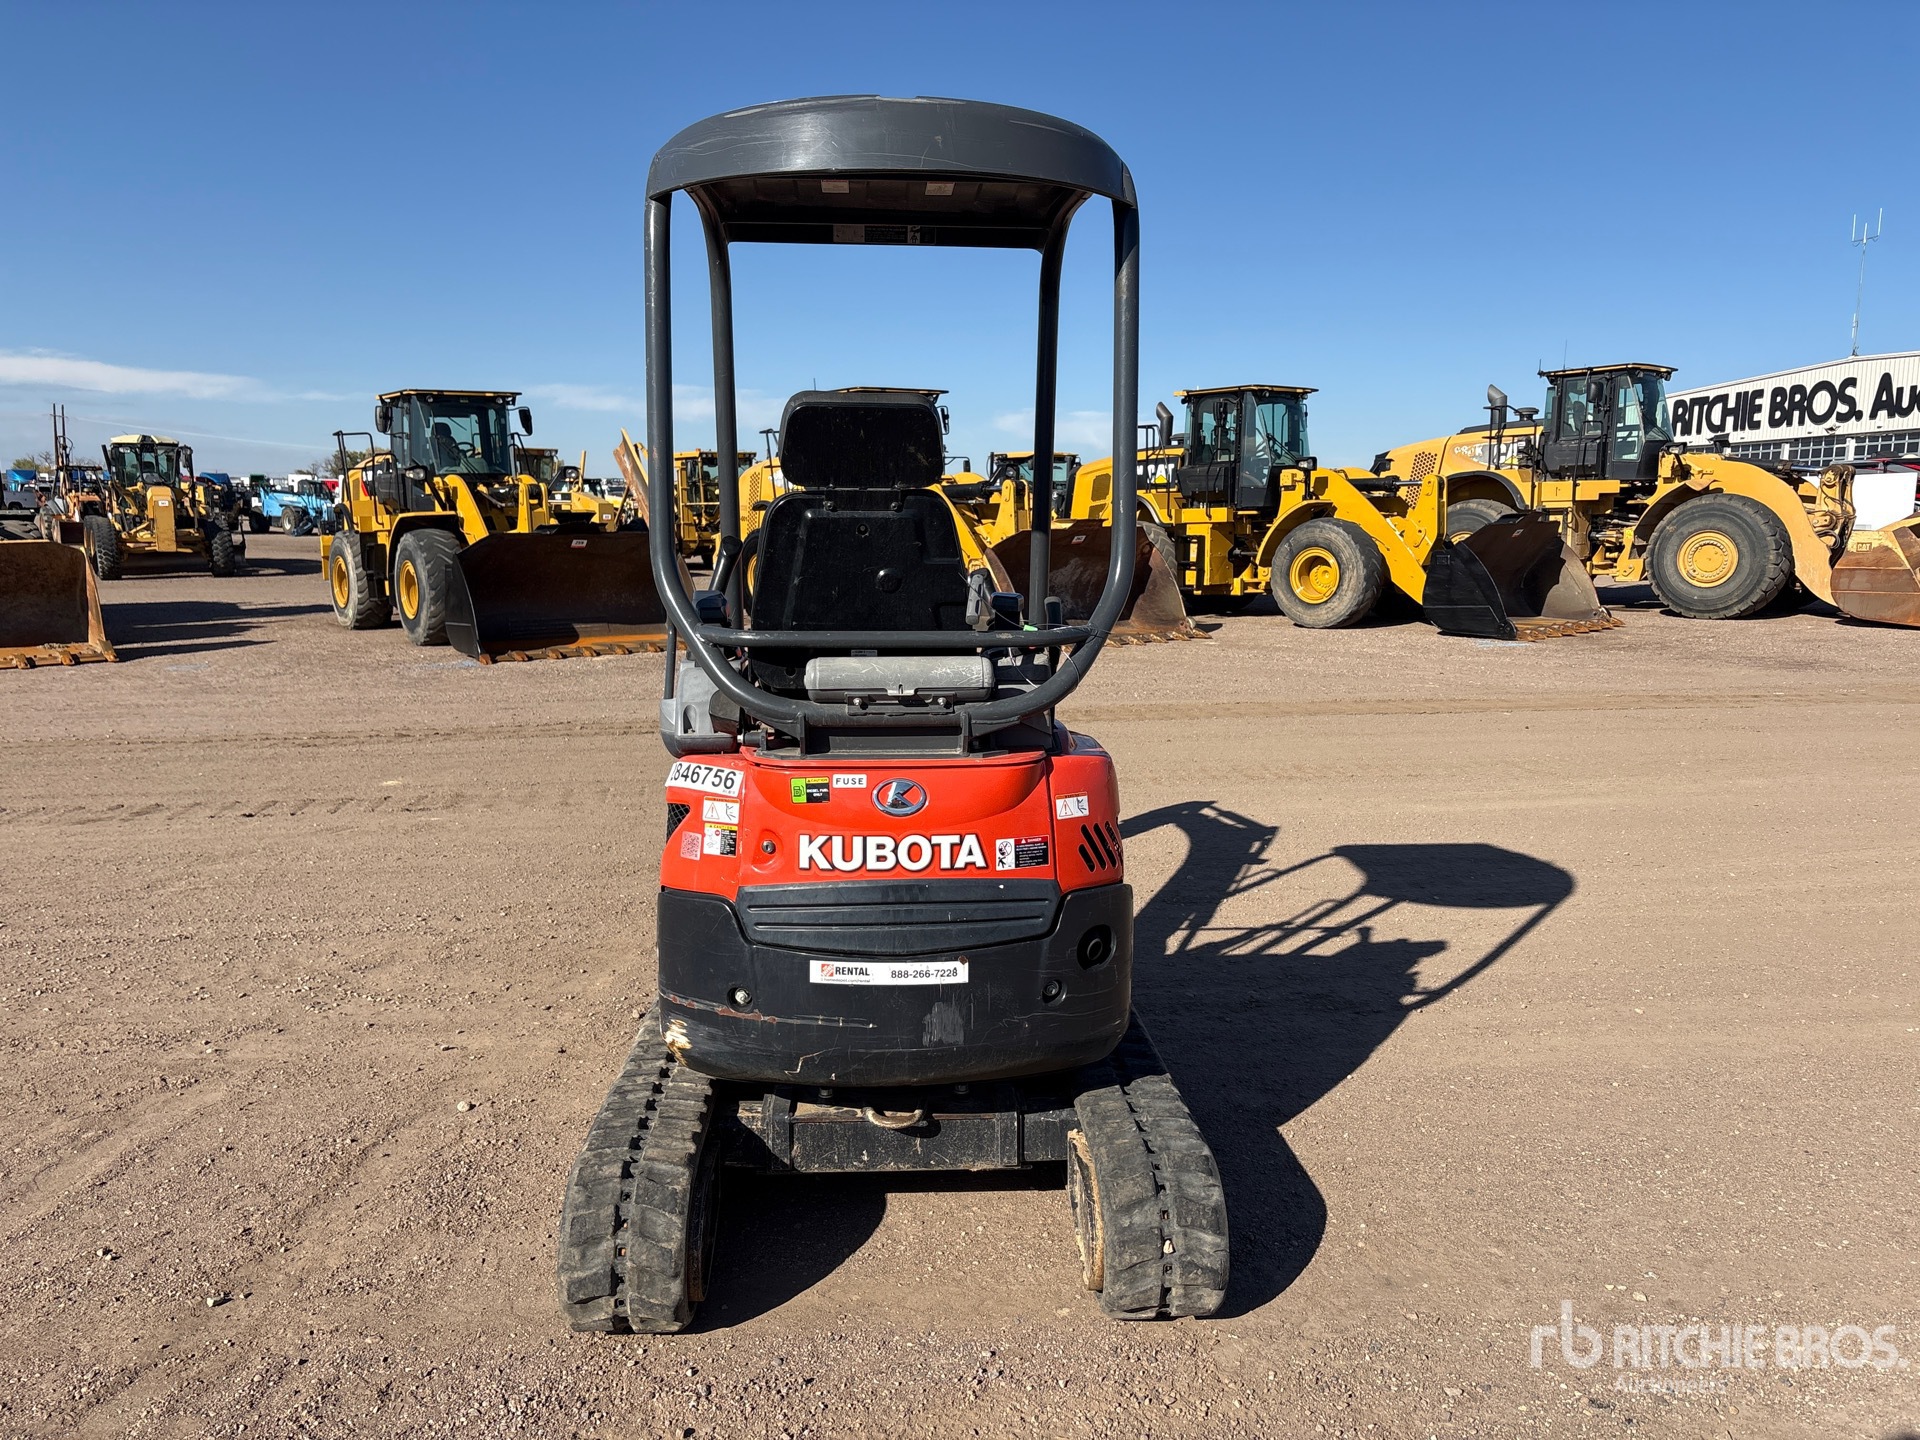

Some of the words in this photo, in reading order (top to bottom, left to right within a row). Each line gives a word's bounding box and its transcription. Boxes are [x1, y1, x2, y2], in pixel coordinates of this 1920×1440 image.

[1672, 388, 1765, 437] RITCHIE
[1768, 376, 1864, 429] BROS.
[1869, 371, 1920, 421] Au
[1146, 463, 1174, 484] CAT
[1857, 543, 1871, 551] CAT
[835, 777, 864, 786] FUSE
[798, 833, 988, 872] KUBOTA
[834, 966, 871, 977] RENTAL
[890, 968, 959, 979] 888-266-7228
